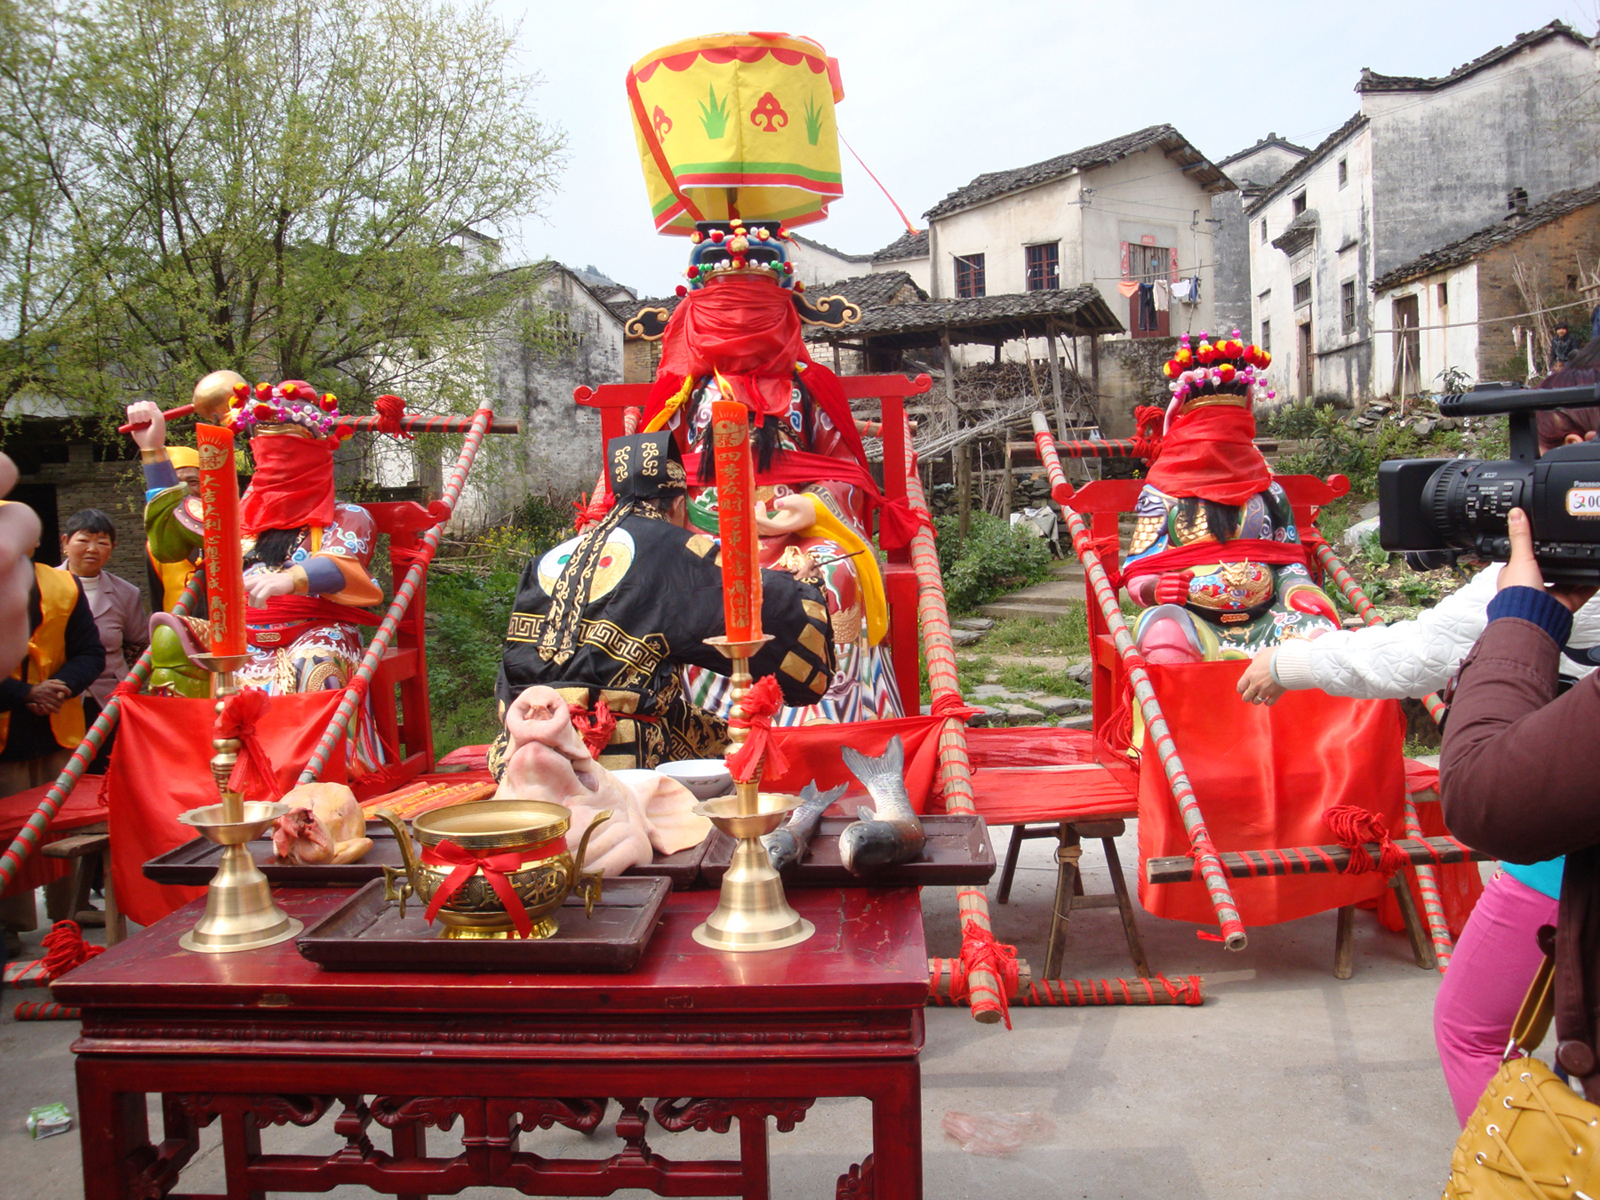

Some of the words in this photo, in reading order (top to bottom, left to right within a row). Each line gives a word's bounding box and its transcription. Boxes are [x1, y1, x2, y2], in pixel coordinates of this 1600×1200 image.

[201, 474, 224, 592] 大吉大利心想事成
[717, 451, 747, 577] 四季发财万事如意
